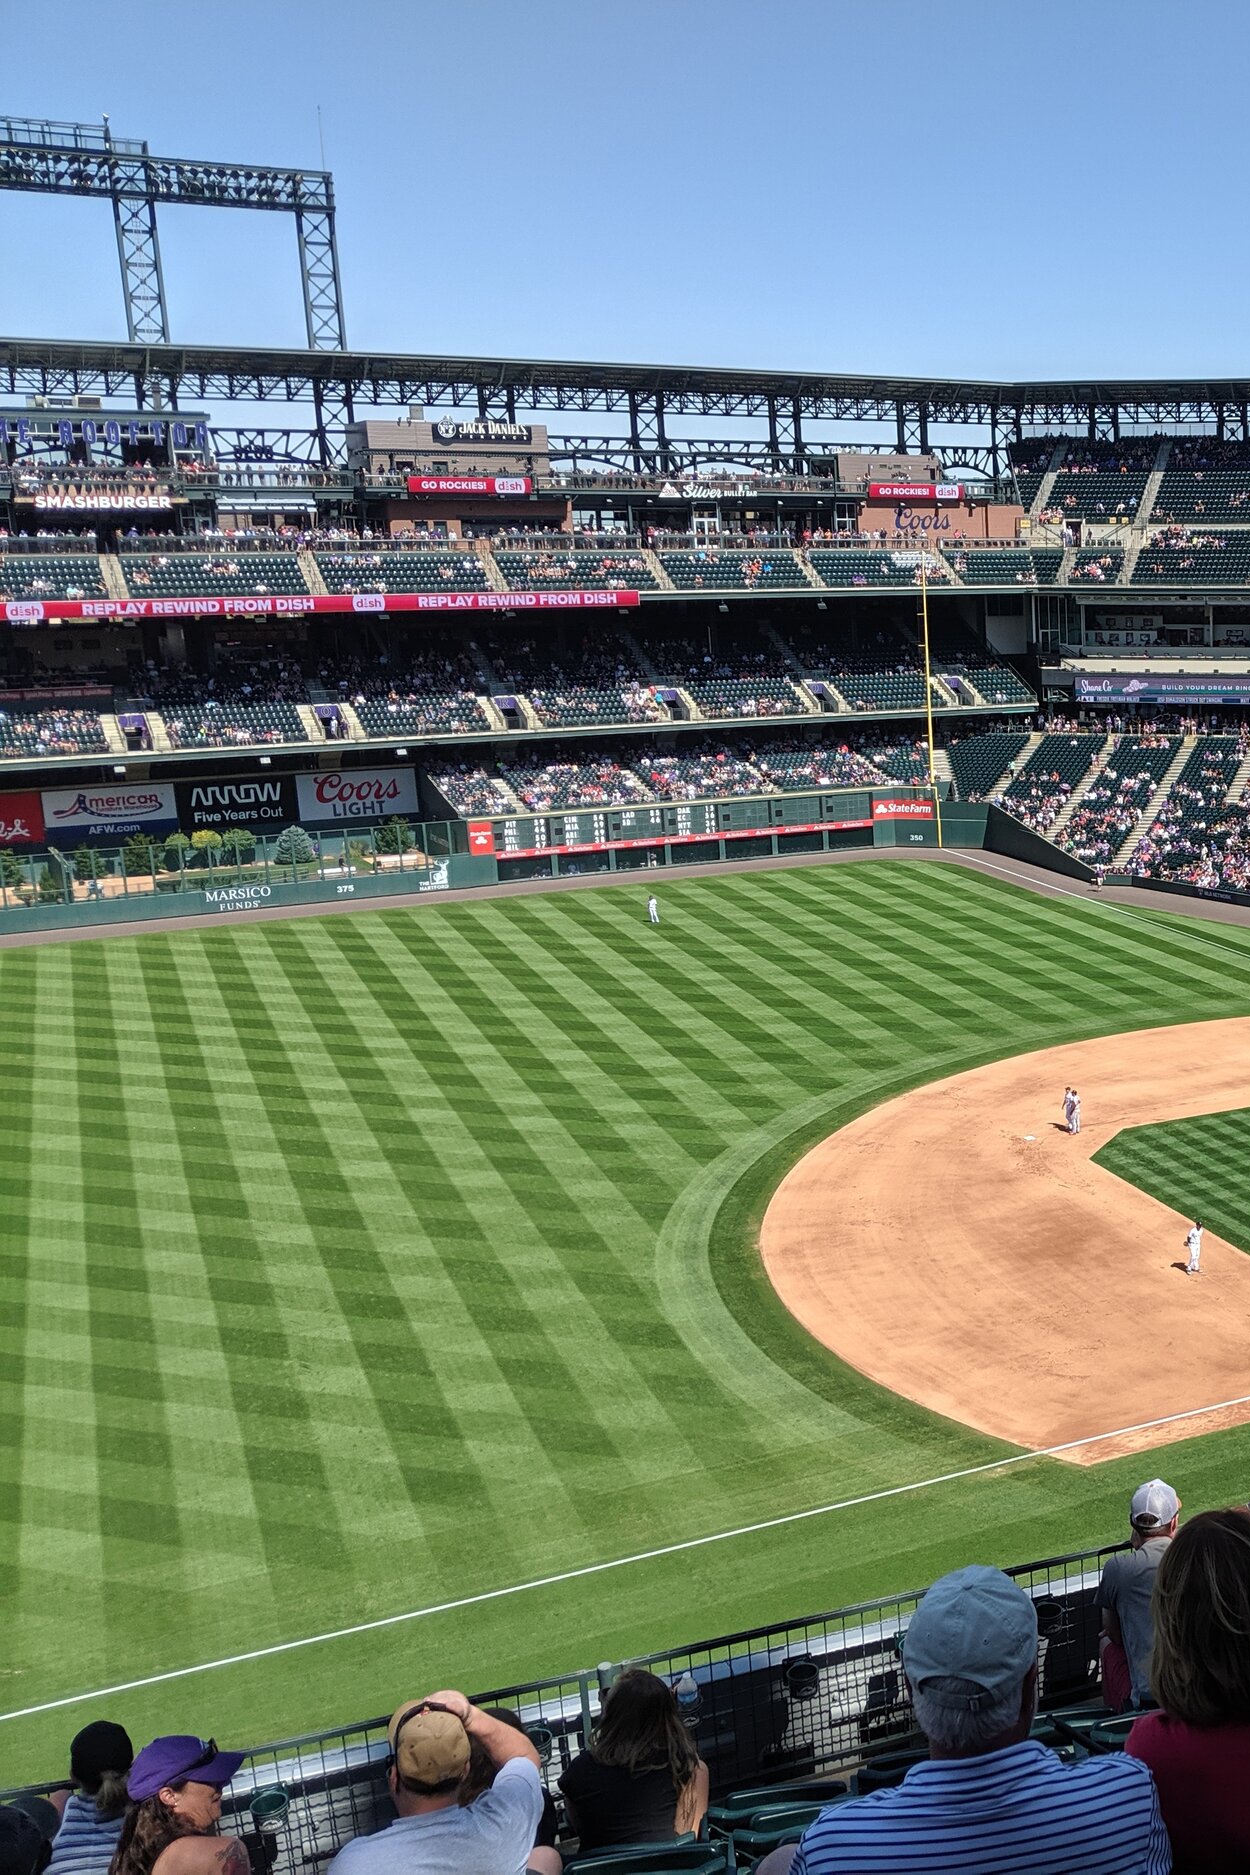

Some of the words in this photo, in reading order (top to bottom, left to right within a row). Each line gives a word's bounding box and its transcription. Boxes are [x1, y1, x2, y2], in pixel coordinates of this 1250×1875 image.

[459, 420, 486, 435] JACK
[421, 480, 437, 490] GO
[440, 481, 487, 490] ROCKIES!
[498, 480, 522, 492] dish
[682, 481, 723, 499] Silver
[879, 487, 892, 496] GO
[893, 487, 930, 496] ROCKIES!
[938, 486, 957, 497] dish
[35, 495, 173, 509] SMASHBURGER
[894, 507, 952, 530] Coors
[356, 596, 382, 609] dish
[418, 595, 474, 608] REPLAY
[478, 594, 536, 607] REWIND
[539, 593, 582, 606] FROM
[584, 592, 617, 605] DISH
[10, 605, 41, 619] dish
[82, 602, 148, 617] REPLAY
[152, 600, 220, 615] REWIND
[224, 599, 273, 613] FROM
[276, 598, 315, 612] DISH
[1081, 679, 1102, 693] Shane
[313, 774, 401, 804] Coors
[194, 811, 221, 823] Five
[222, 809, 258, 821] Years
[260, 806, 284, 819] Out
[333, 800, 386, 817] LIGHT
[887, 803, 931, 814] StateFarm
[88, 824, 141, 835] AFW.com
[205, 886, 272, 902] MARSICO
[337, 885, 355, 894] 375
[220, 900, 259, 911] FUNDS
